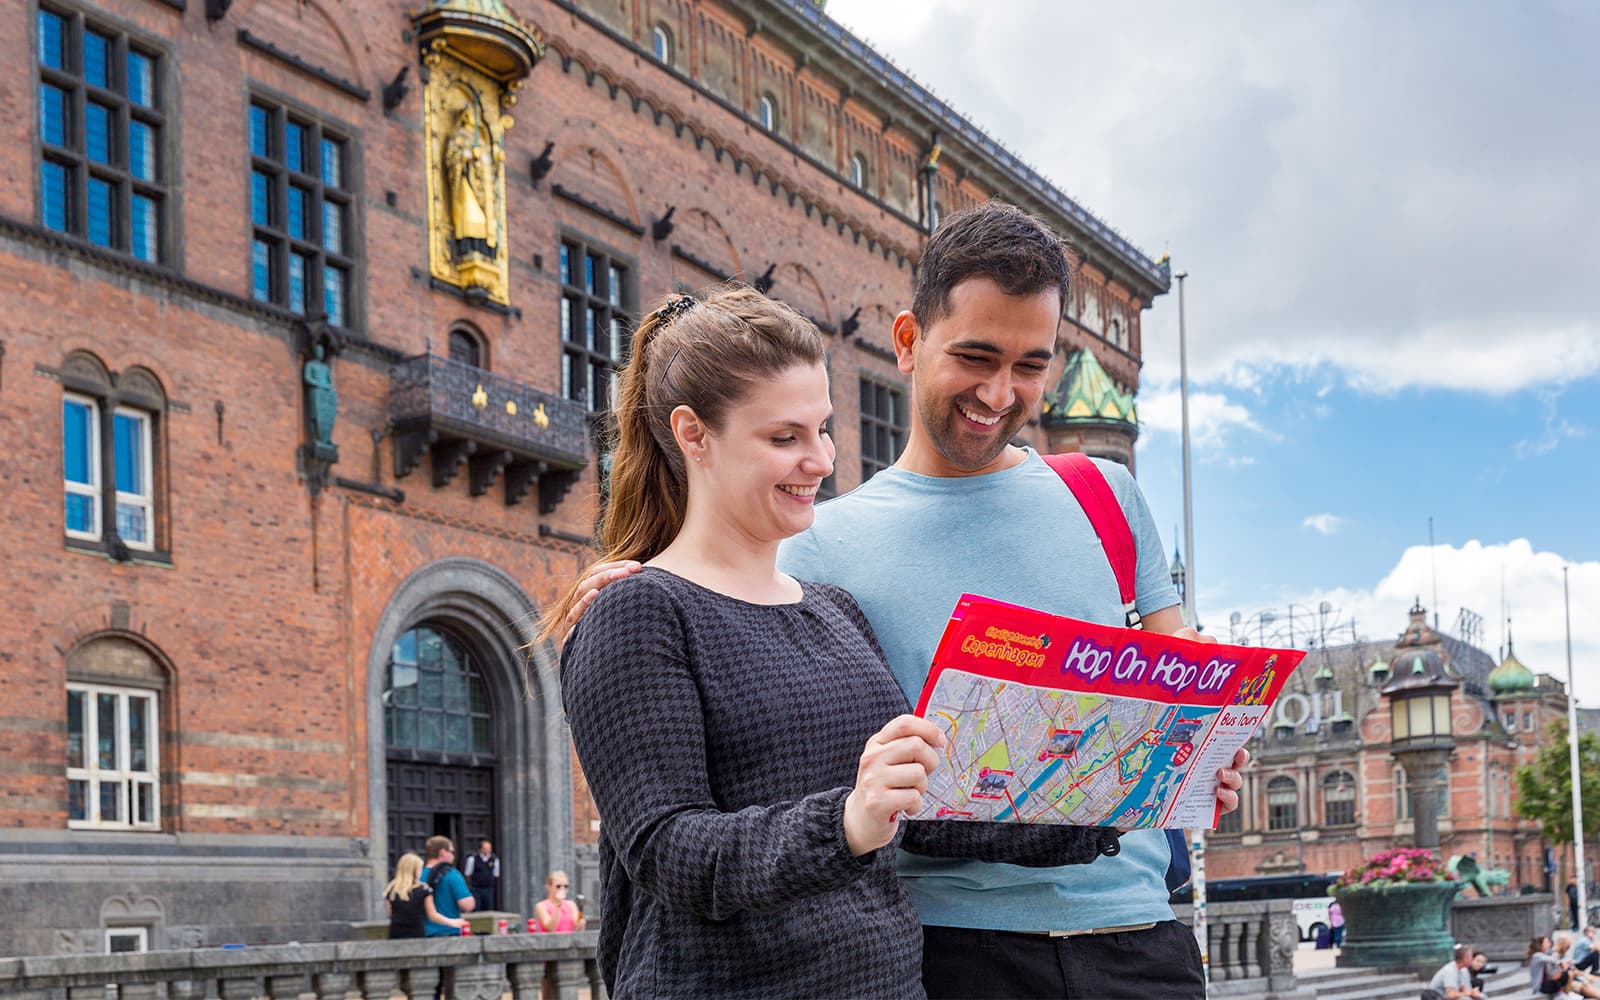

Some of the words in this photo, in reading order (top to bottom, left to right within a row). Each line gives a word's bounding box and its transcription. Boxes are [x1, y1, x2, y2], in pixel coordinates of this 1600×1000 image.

[961, 634, 1045, 668] Copenhagen
[1065, 640, 1112, 680] Hop
[1114, 646, 1147, 681] On
[1151, 653, 1197, 692] Hop
[1197, 659, 1237, 690] Off
[1220, 712, 1237, 726] Bus
[1237, 712, 1259, 726] Tours
